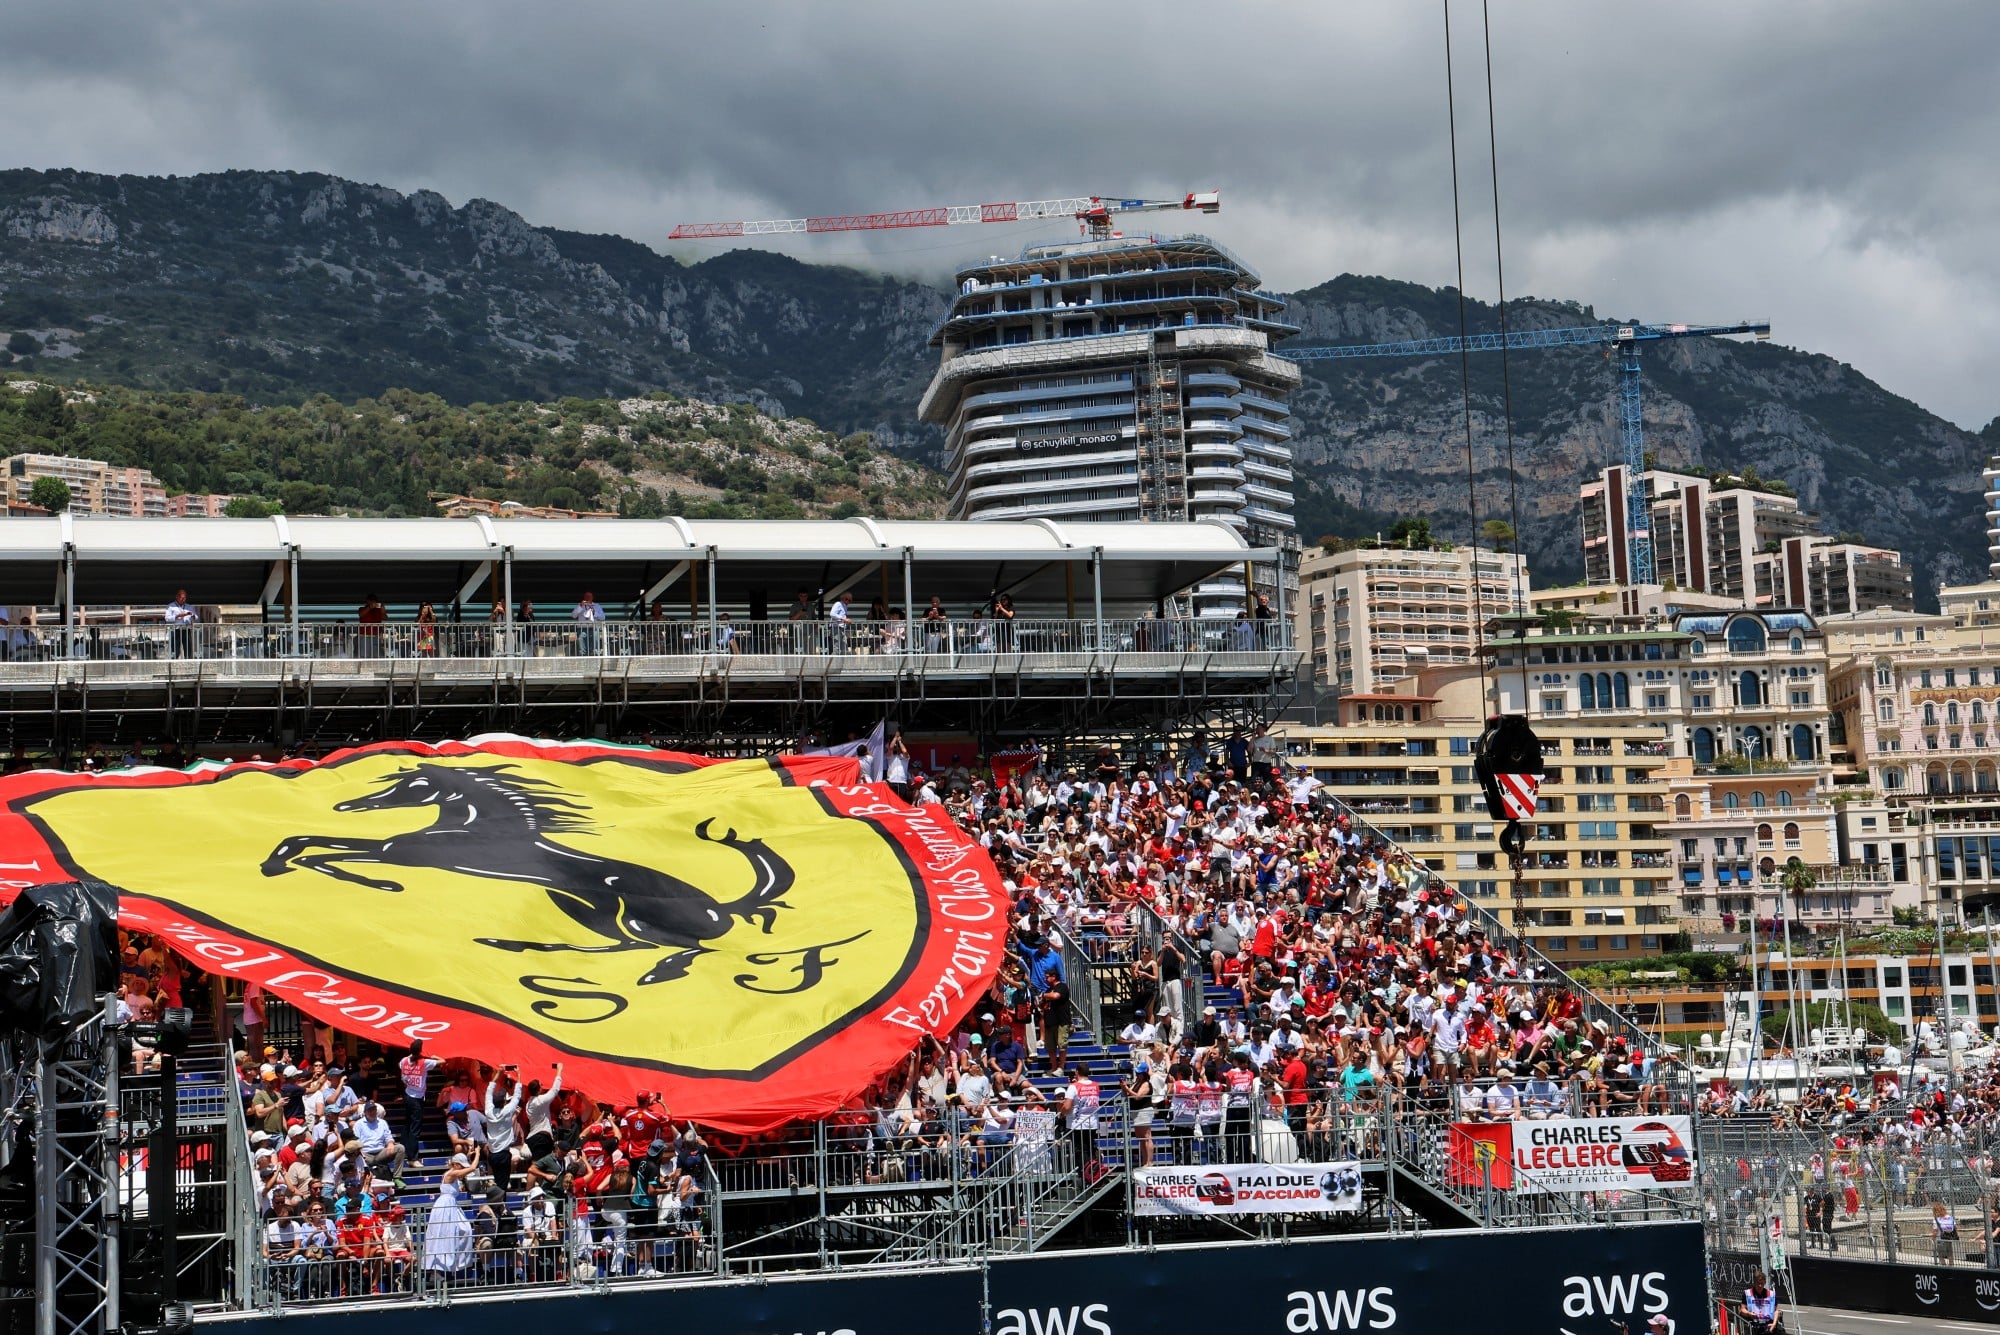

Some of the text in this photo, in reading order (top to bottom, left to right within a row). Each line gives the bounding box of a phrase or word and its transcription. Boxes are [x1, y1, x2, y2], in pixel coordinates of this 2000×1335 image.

[1033, 434, 1117, 449] schuylkill_monaco
[932, 869, 995, 921] Club
[881, 927, 993, 1033] Ferrari
[265, 970, 451, 1041] Cuore
[1531, 1125, 1622, 1145] CHARLES
[1517, 1144, 1621, 1169] LECLERC
[1145, 1174, 1197, 1186] CHARLES
[1237, 1175, 1315, 1187] HAI DUE
[1532, 1177, 1573, 1185] ARCHE
[1603, 1175, 1628, 1183] CLUB
[1567, 1168, 1615, 1176] OFFICIAL
[1137, 1185, 1195, 1199] LECLERC
[1237, 1188, 1321, 1200] D'ACCIAIO
[1915, 1274, 1938, 1291] aws
[1975, 1279, 2000, 1297] aws
[1562, 1271, 1669, 1318] aws
[996, 1303, 1112, 1335] aws
[1286, 1286, 1397, 1334] aws
